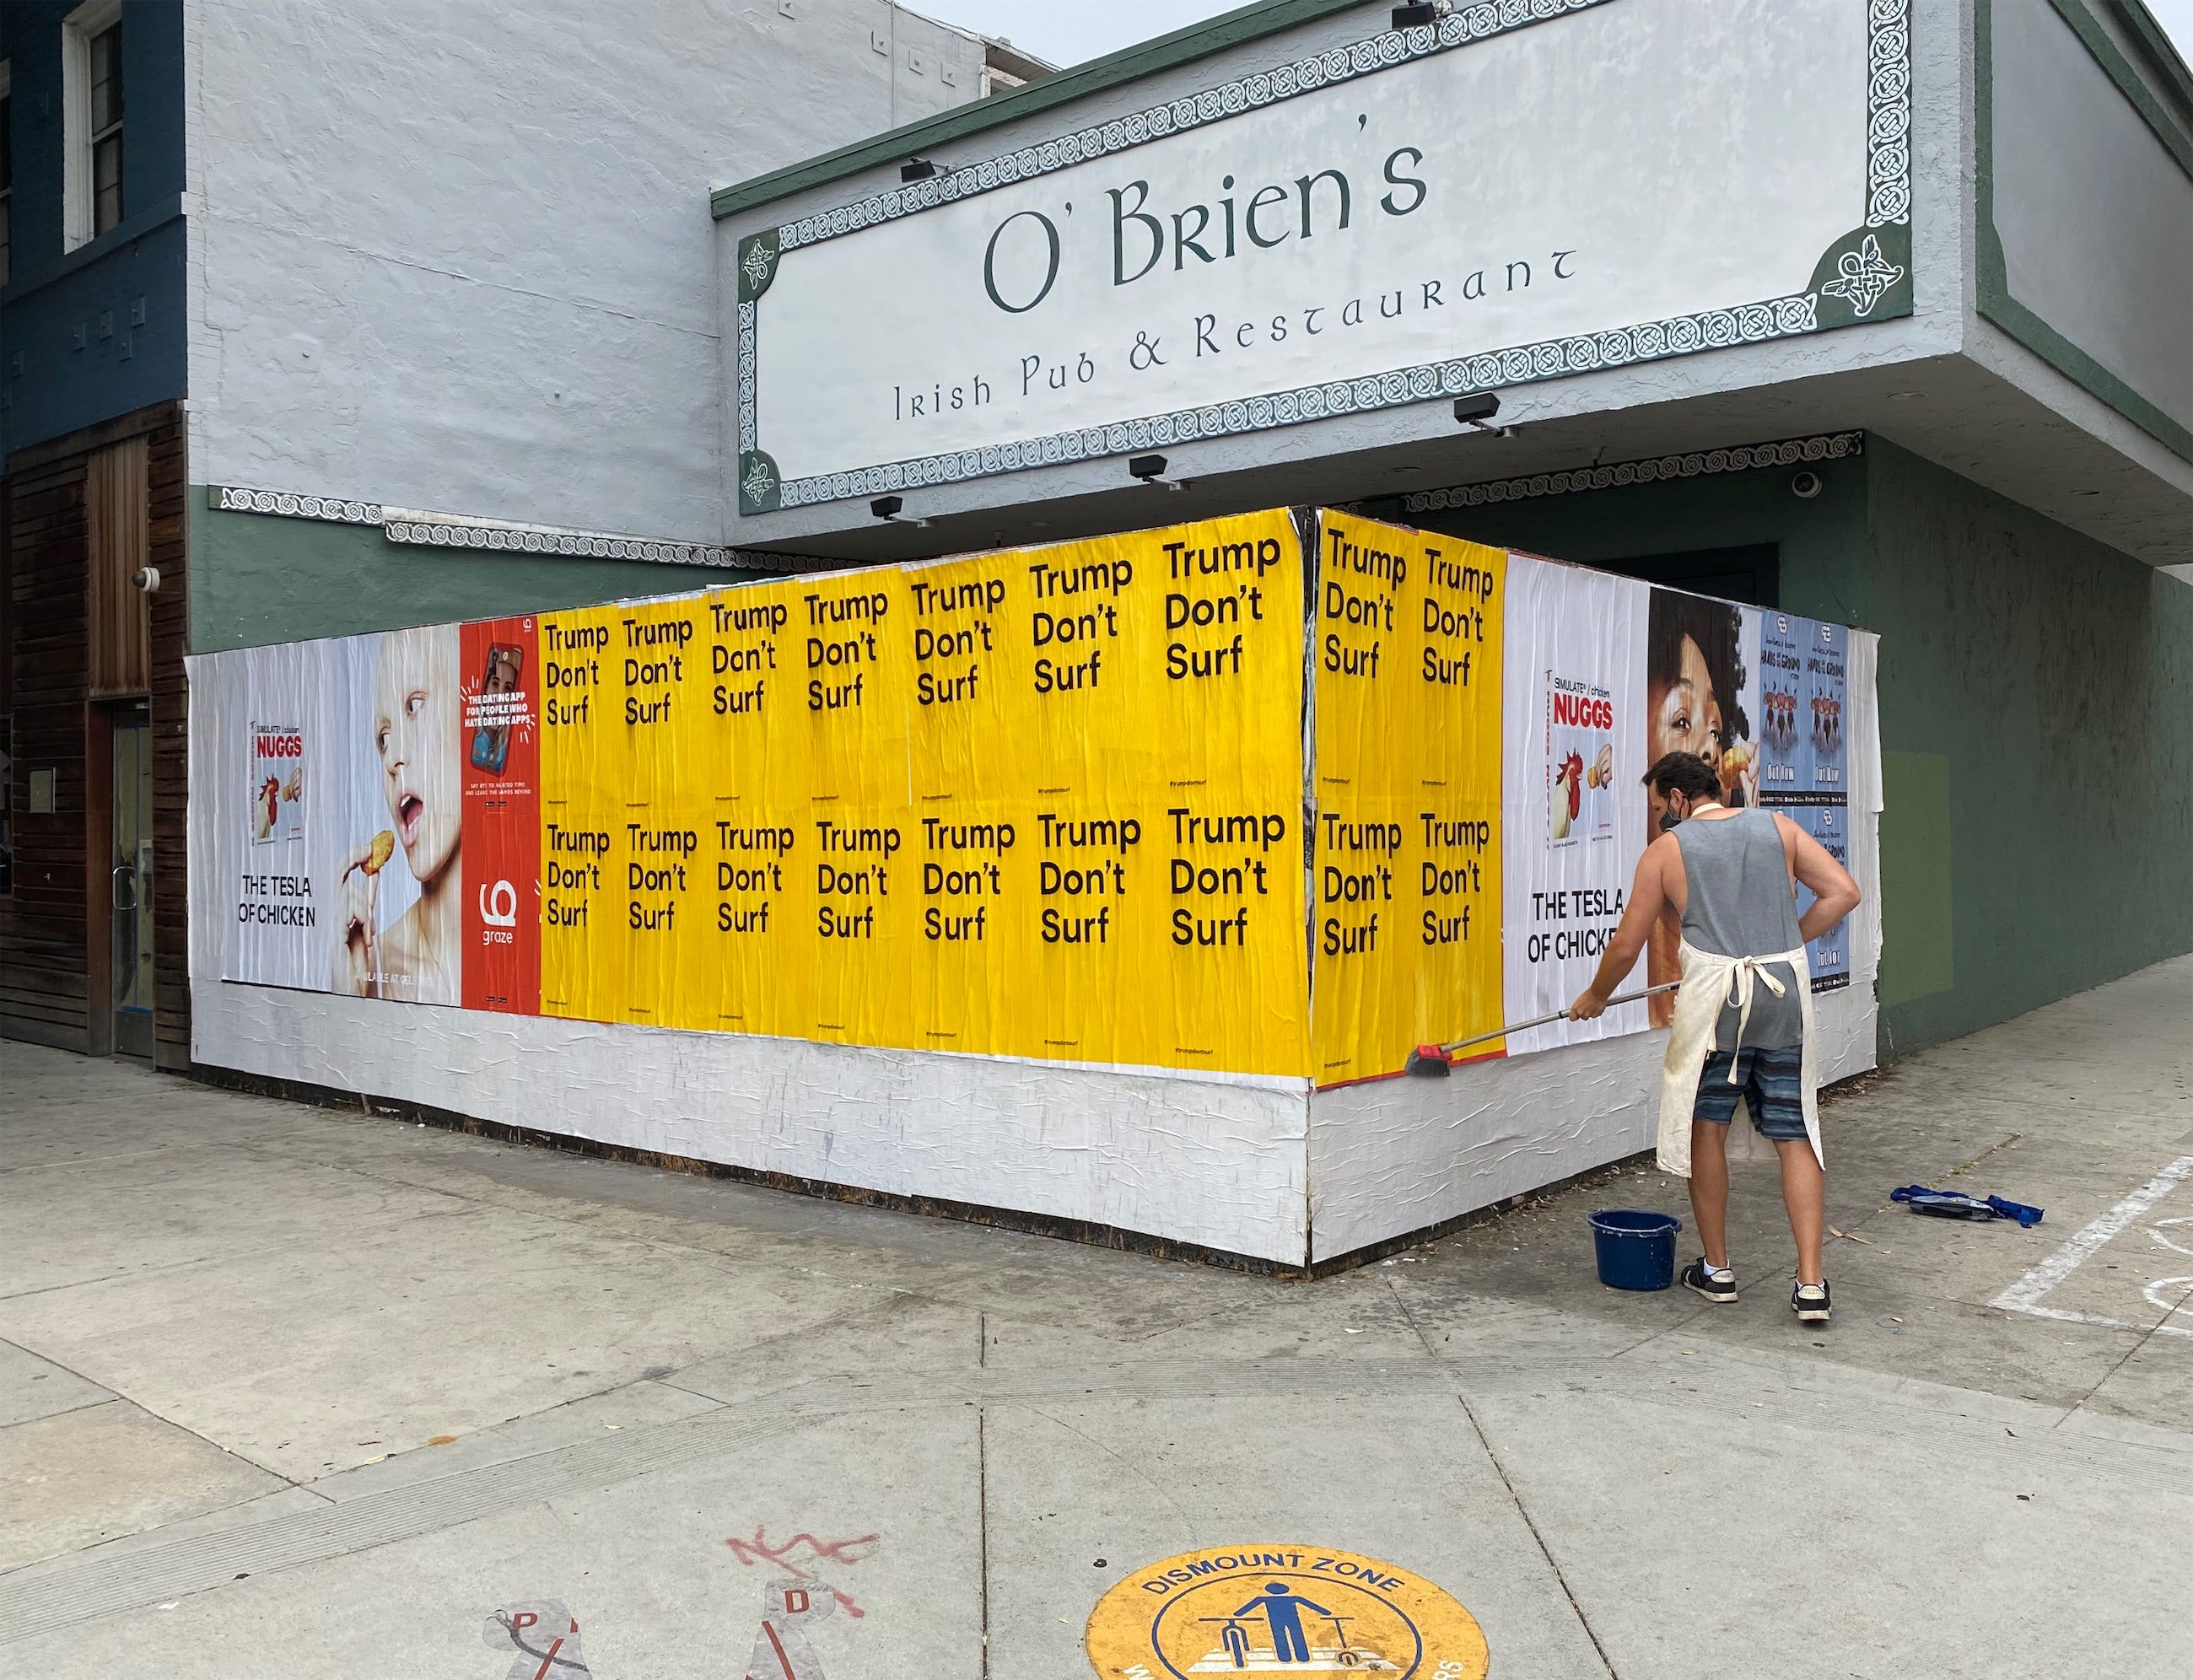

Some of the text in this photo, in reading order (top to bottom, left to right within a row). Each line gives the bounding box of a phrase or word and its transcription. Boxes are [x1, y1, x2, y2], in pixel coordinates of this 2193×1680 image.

[894, 250, 1576, 421] Irish Pub & Restaurant
[1163, 539, 1280, 579] Trump
[1328, 528, 1407, 587] Trump
[1425, 548, 1494, 598] Trump
[911, 579, 1005, 616] Trump
[1030, 560, 1133, 599] Trump
[709, 602, 788, 635] Trump
[804, 593, 887, 626] Trump
[1033, 604, 1118, 647] Don't
[1167, 584, 1263, 630] Don't
[1326, 582, 1393, 632] Don't
[1424, 598, 1483, 643] Don't
[545, 624, 609, 653] Trump
[622, 619, 693, 649] Trump
[808, 631, 876, 669] Don't
[916, 620, 993, 661] Don't
[547, 659, 599, 687] Don't
[625, 654, 682, 687] Don't
[713, 640, 776, 674] Don't
[1035, 650, 1101, 693] Surf
[1167, 634, 1242, 680] Surf
[1325, 634, 1379, 679] Surf
[1423, 647, 1470, 687] Surf
[468, 692, 525, 705] THE DATING APP
[714, 680, 764, 714] Surf
[809, 673, 863, 711] Surf
[918, 665, 978, 706] Surf
[465, 714, 531, 727] HATE DATING APPS
[466, 703, 528, 716] FOR PEOPLE WHO
[547, 696, 589, 726] Surf
[625, 692, 671, 726] Surf
[1554, 692, 1613, 730] NUGGS
[257, 735, 302, 758] NUGGS
[547, 825, 610, 858] Trump
[627, 823, 698, 859] Trump
[716, 821, 795, 858] Trump
[816, 821, 901, 859] Trump
[922, 818, 1016, 857] Trump
[1037, 814, 1141, 854] Trump
[1167, 808, 1285, 852] Trump
[1323, 813, 1402, 859] Trump
[1420, 812, 1490, 853] Trump
[242, 875, 312, 897] THE TESLA
[548, 861, 600, 891] Don't
[629, 863, 687, 891] Don't
[718, 862, 782, 891] Don't
[818, 864, 887, 896] Don't
[924, 862, 1001, 895] Don't
[1041, 859, 1125, 896] Don't
[1171, 858, 1268, 895] Don't
[1324, 865, 1392, 903] Don't
[1422, 860, 1480, 897] Don't
[239, 902, 315, 927] OF CHICKEN
[547, 899, 588, 928] Surf
[628, 902, 675, 931] Surf
[718, 902, 768, 933] Surf
[818, 907, 874, 939] Surf
[1533, 888, 1625, 921] THE TESLA
[482, 930, 513, 945] graze
[924, 907, 985, 940] Surf
[1041, 906, 1109, 944] Surf
[1172, 907, 1247, 946] Surf
[1324, 913, 1378, 956] Surf
[1423, 905, 1470, 945] Surf
[1528, 928, 1617, 963] OF CHICK
[1141, 1553, 1405, 1596] DISMOUNT ZONE
